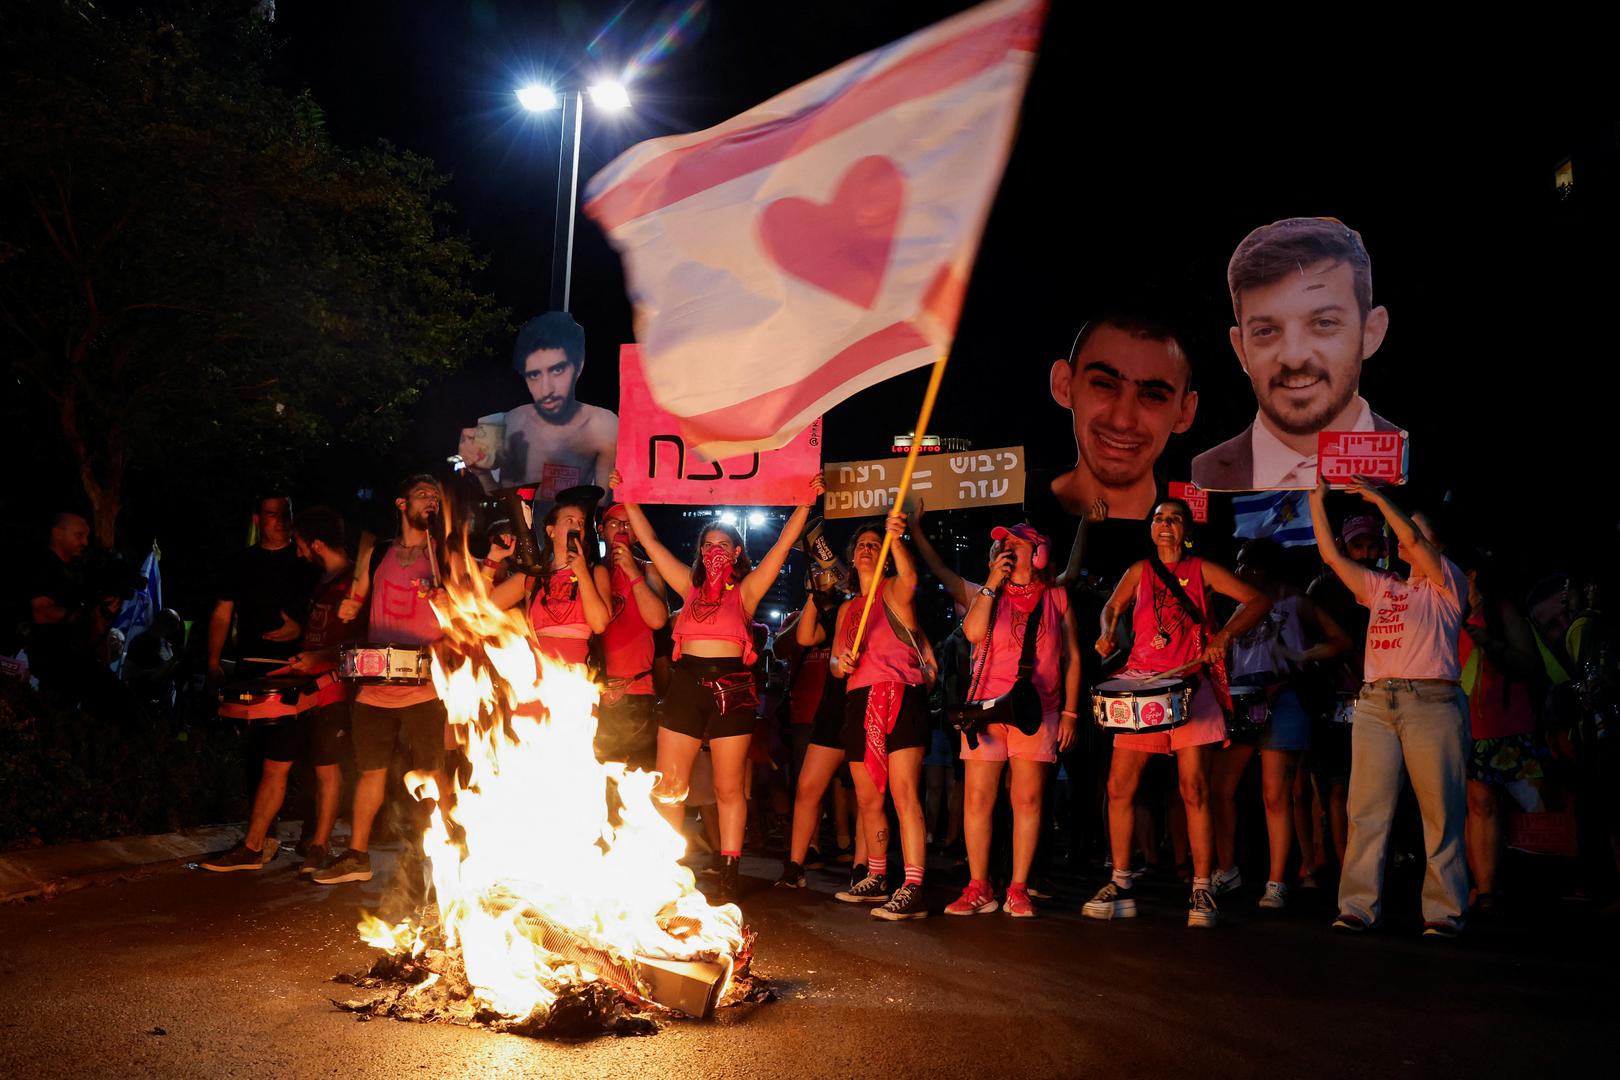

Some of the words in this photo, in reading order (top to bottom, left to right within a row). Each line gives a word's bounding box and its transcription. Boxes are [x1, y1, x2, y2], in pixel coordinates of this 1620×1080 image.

[1343, 436, 1395, 454] עדיין
[840, 464, 886, 484] רצח
[950, 452, 1018, 475] כיבוש
[958, 477, 1009, 499] עזה
